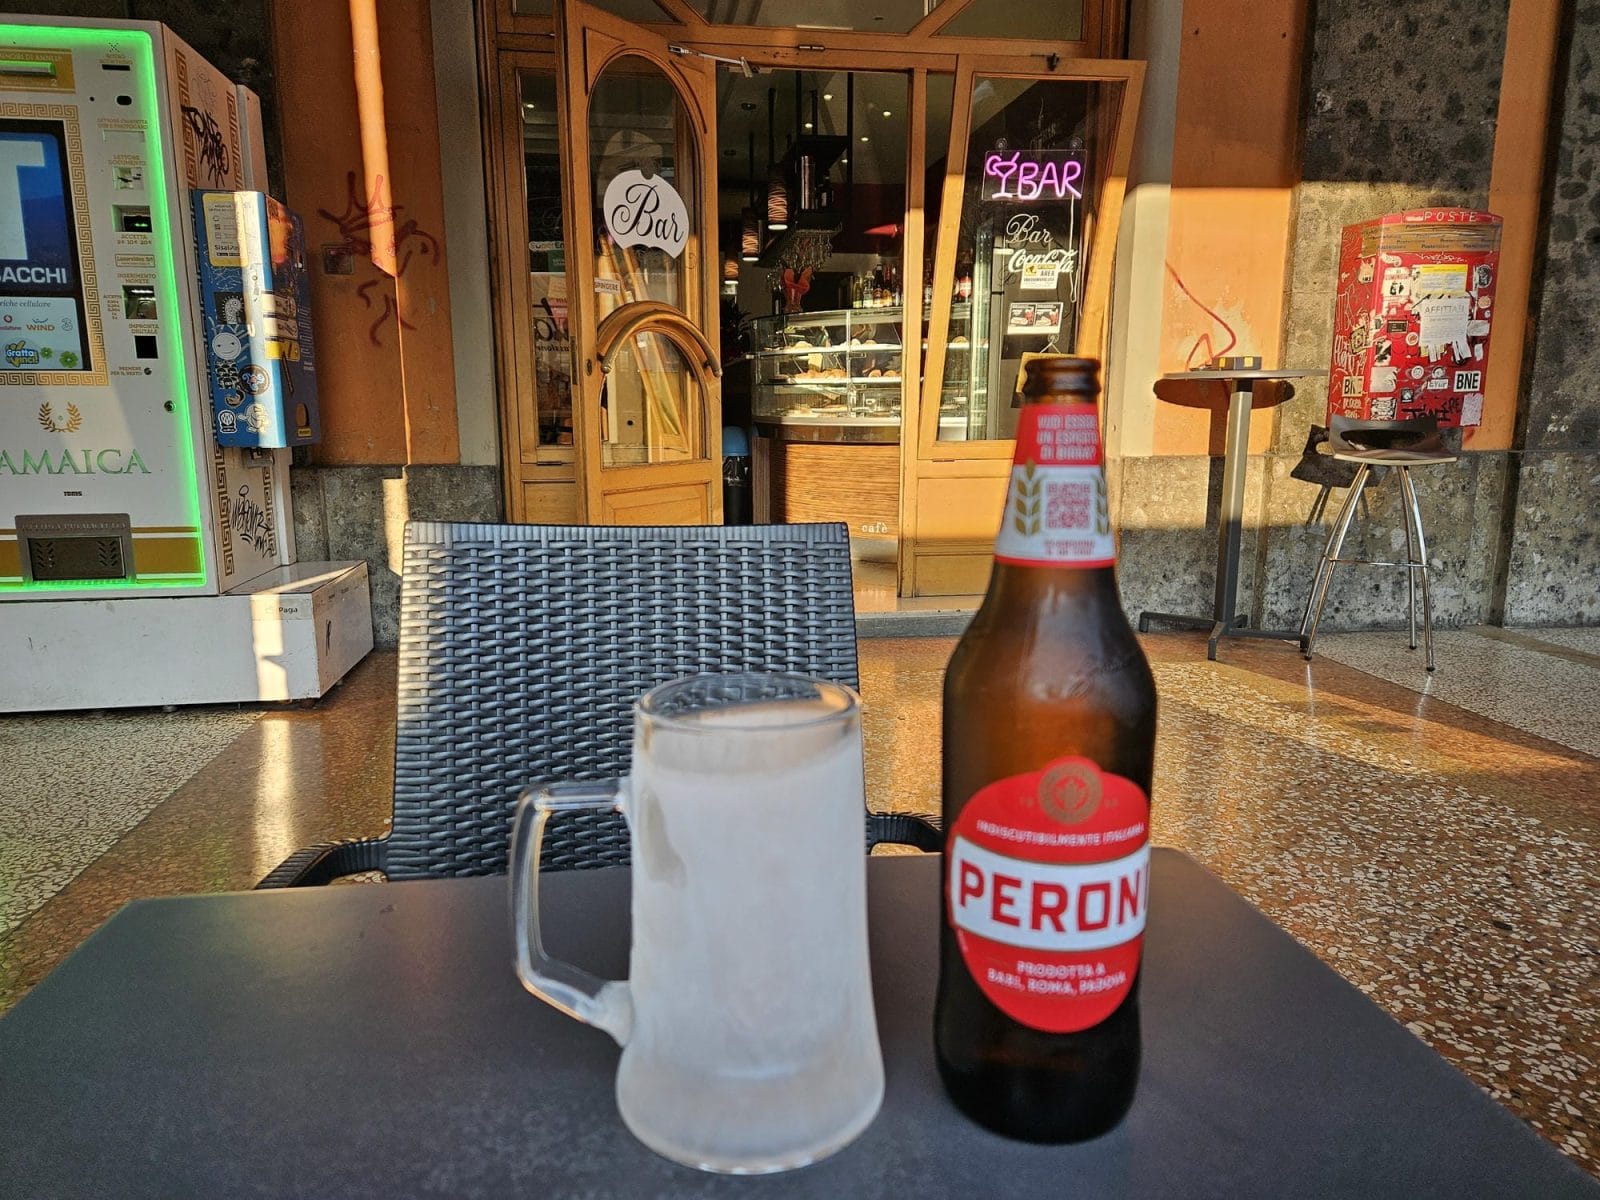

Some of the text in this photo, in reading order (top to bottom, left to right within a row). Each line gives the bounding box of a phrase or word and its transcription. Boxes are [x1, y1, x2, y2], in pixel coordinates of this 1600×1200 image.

[1018, 161, 1082, 200] BAR
[611, 183, 685, 243] Bar
[1424, 211, 1478, 222] POSTE
[1006, 213, 1054, 244] Bar
[0, 266, 67, 284] ACCHI
[20, 300, 51, 308] cellulare
[6, 348, 35, 358] Gratta
[1457, 373, 1479, 389] BNE
[1016, 960, 1106, 979] PRODOTTA A
[987, 967, 1026, 992] BARI,
[1027, 976, 1077, 997] ROMA,
